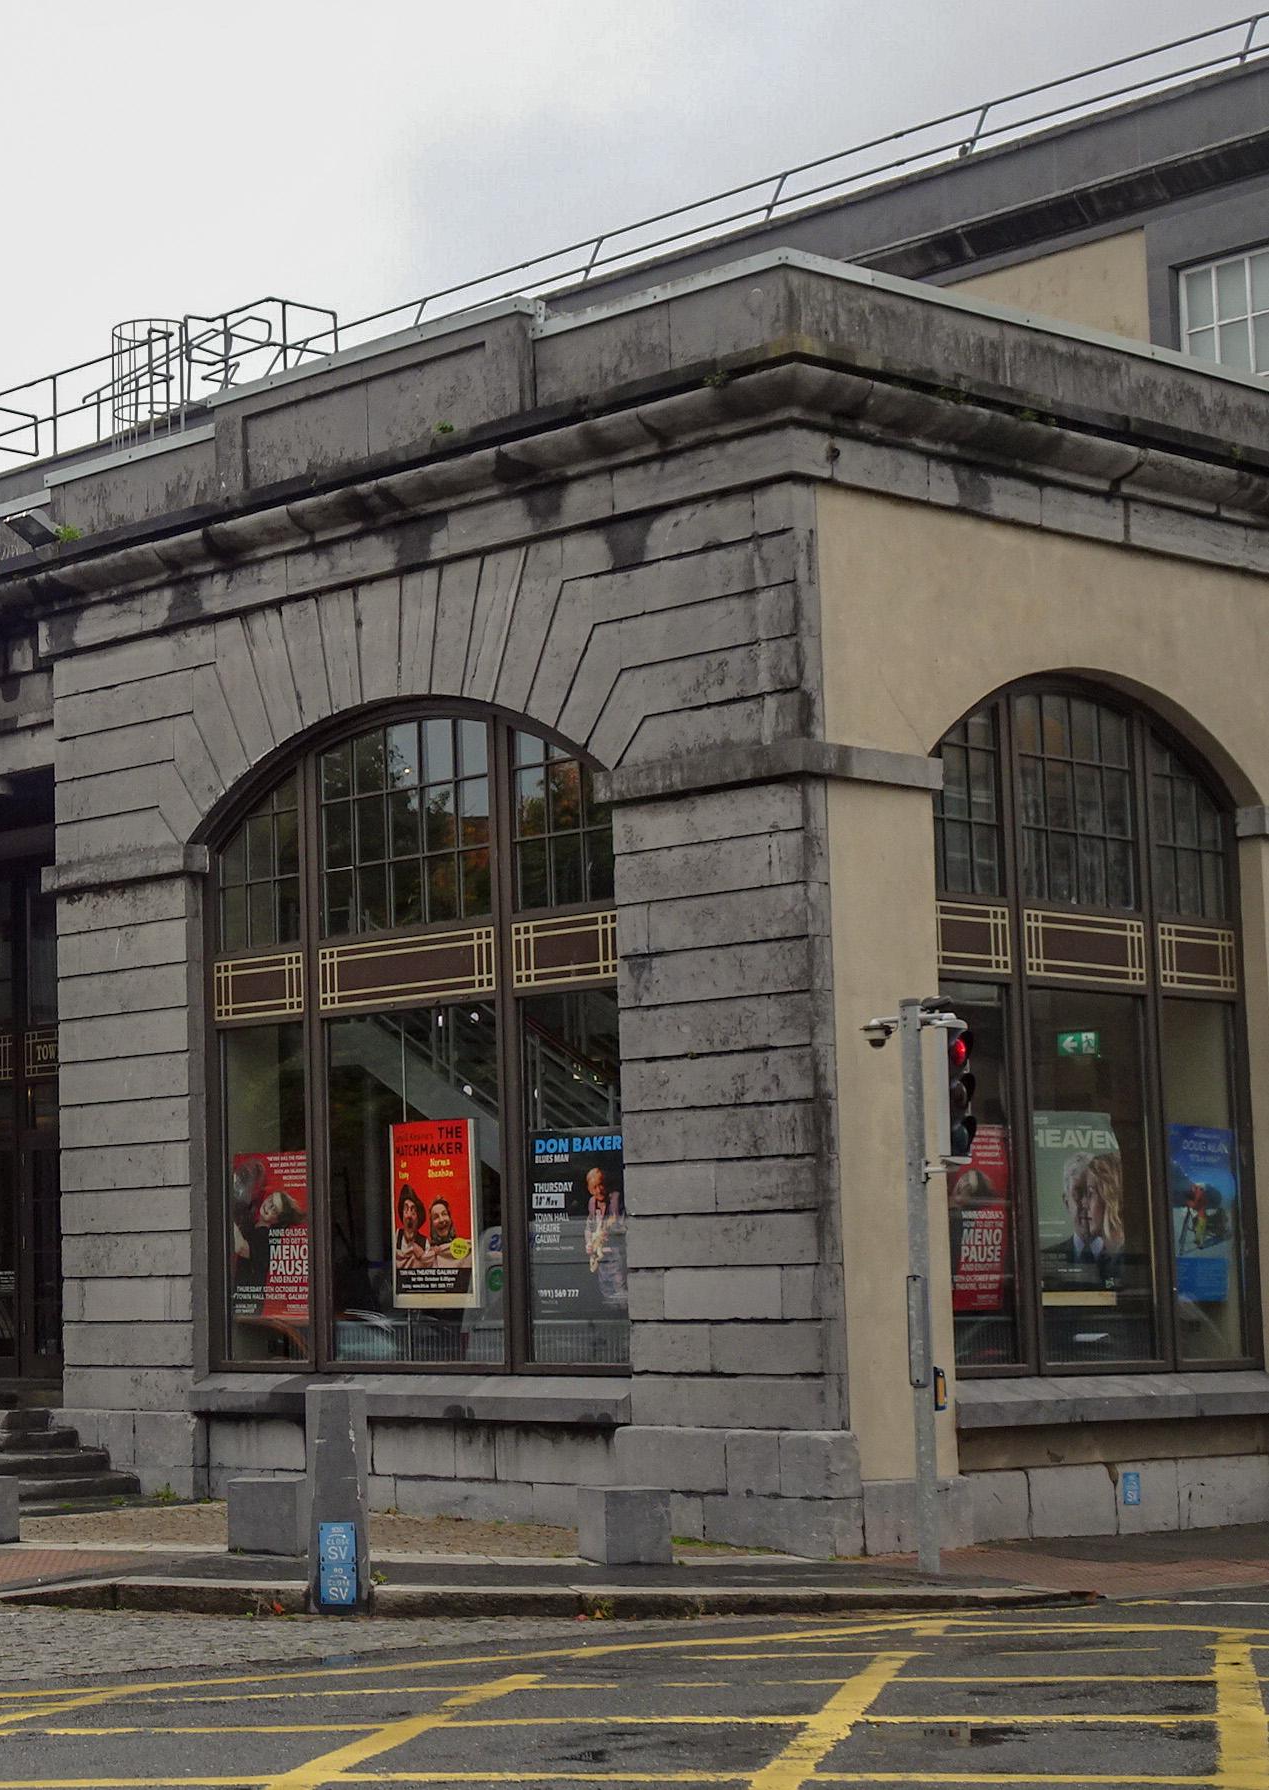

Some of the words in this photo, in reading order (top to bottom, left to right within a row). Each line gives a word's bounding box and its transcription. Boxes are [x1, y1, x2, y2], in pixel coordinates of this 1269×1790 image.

[437, 1126, 462, 1139] THE
[396, 1142, 463, 1156] MATCHMAKER
[535, 1138, 569, 1154] DON
[572, 1135, 623, 1152] BAKER
[535, 1154, 553, 1164] BLUES
[554, 1154, 569, 1163] MAN
[534, 1182, 573, 1193] THURSDAY
[534, 1213, 554, 1222] TOWN
[554, 1212, 570, 1222] HALL
[269, 1228, 284, 1237] ANNE
[535, 1223, 561, 1233] THEATRE
[535, 1234, 561, 1243] GALWAY
[961, 1228, 1002, 1245] MENO
[270, 1244, 309, 1260] MENO
[960, 1246, 1001, 1262] PAUSE
[269, 1260, 309, 1276] PAUSE
[269, 1276, 283, 1284] AND
[283, 1276, 302, 1284] ENJOY
[567, 1289, 579, 1298] 777
[328, 1546, 348, 1560] SV
[329, 1587, 349, 1601] SV
